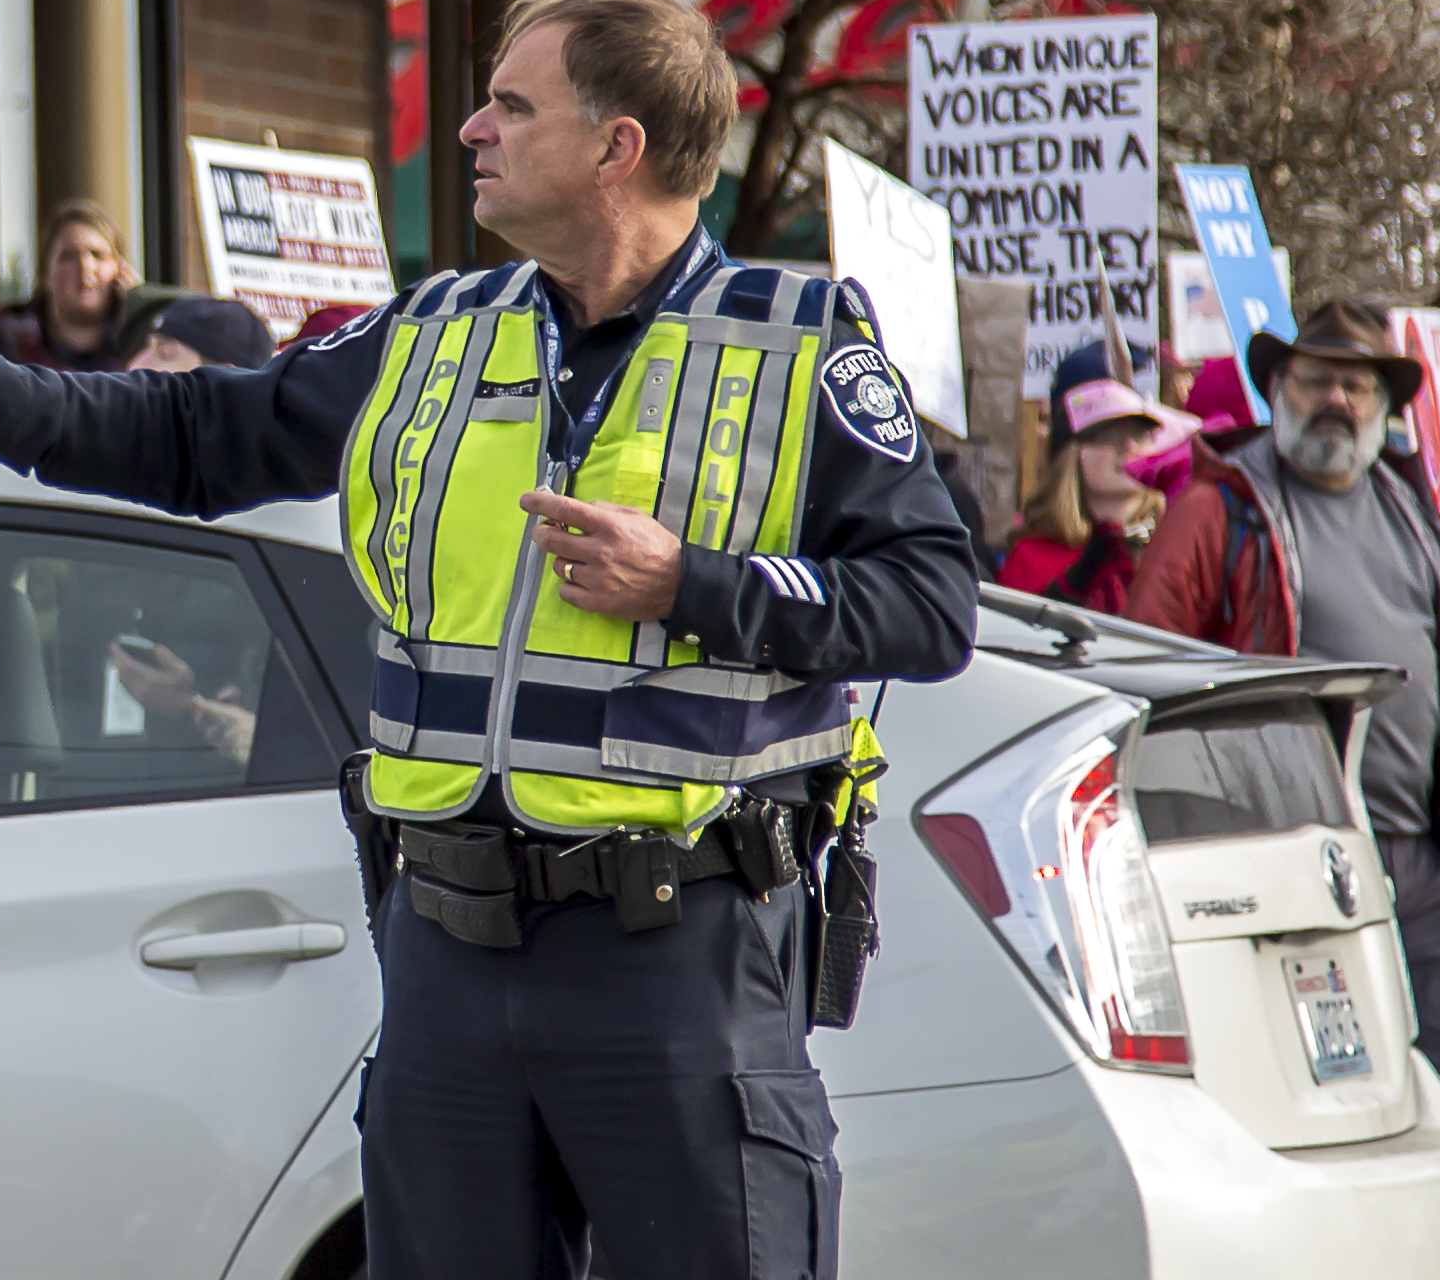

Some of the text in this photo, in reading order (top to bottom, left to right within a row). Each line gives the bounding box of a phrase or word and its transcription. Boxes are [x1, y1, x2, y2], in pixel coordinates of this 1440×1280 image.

[916, 30, 1151, 81] WHEN UNIQUE
[923, 79, 1142, 130] VOICES ARE
[923, 132, 1150, 180] UNITED IN A
[1185, 174, 1251, 215] NOT
[952, 231, 1057, 282] AUSE,
[1207, 220, 1258, 259] MY
[831, 351, 883, 386] SEATTLE
[873, 414, 913, 443] POLICE
